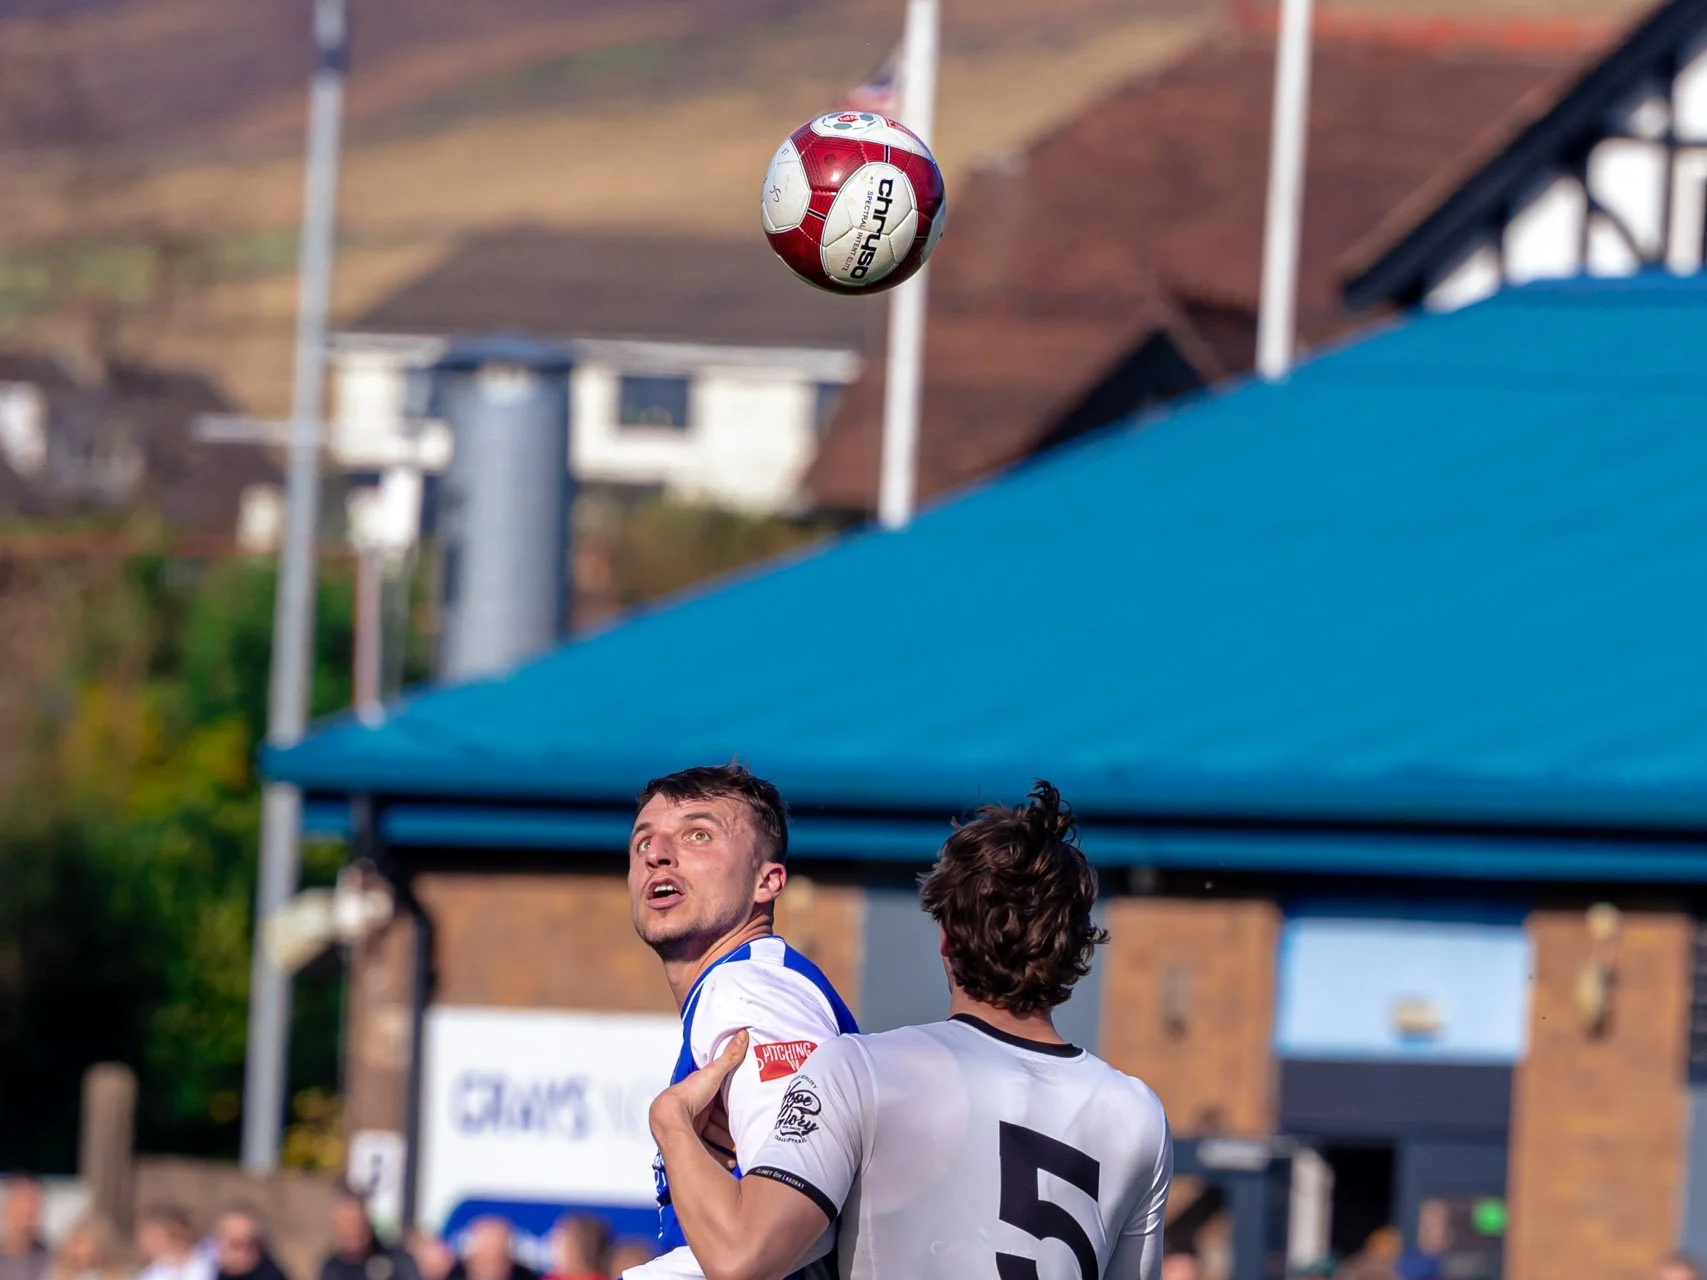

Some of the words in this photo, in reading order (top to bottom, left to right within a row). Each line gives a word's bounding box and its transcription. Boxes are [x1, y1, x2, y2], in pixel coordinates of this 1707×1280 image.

[858, 190, 874, 230] SPECTRAL
[850, 231, 864, 255] INTENT
[840, 254, 855, 273] ELITE
[762, 1042, 812, 1064] PITCHING
